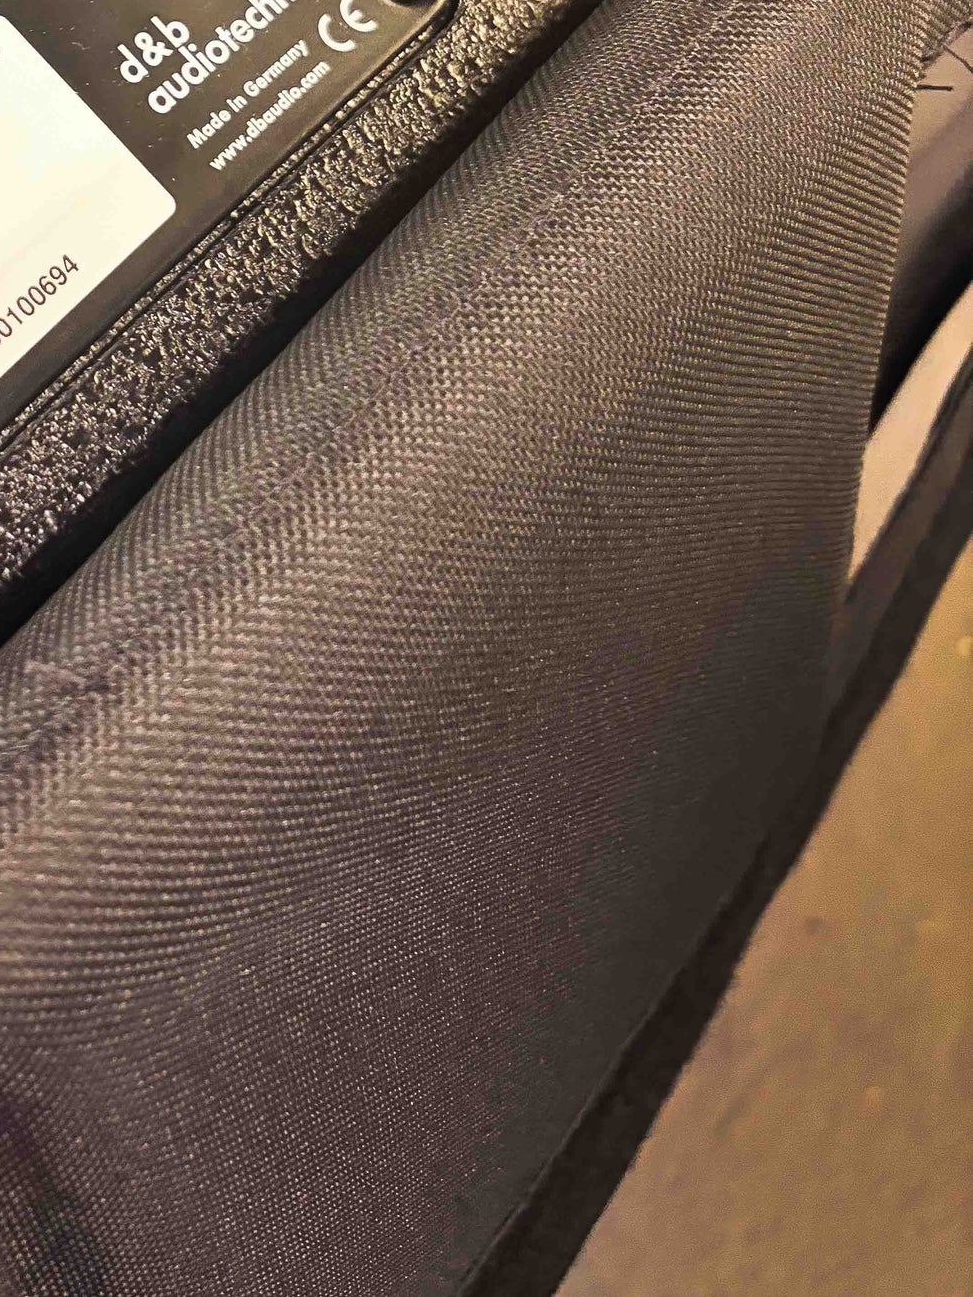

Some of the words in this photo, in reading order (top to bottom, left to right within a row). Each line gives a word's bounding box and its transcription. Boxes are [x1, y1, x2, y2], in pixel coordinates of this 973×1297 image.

[116, 15, 190, 84] d&b
[186, 109, 232, 149] Made
[226, 95, 248, 113] in
[243, 39, 309, 97] Germany
[209, 61, 332, 171] www.dbaudio.com
